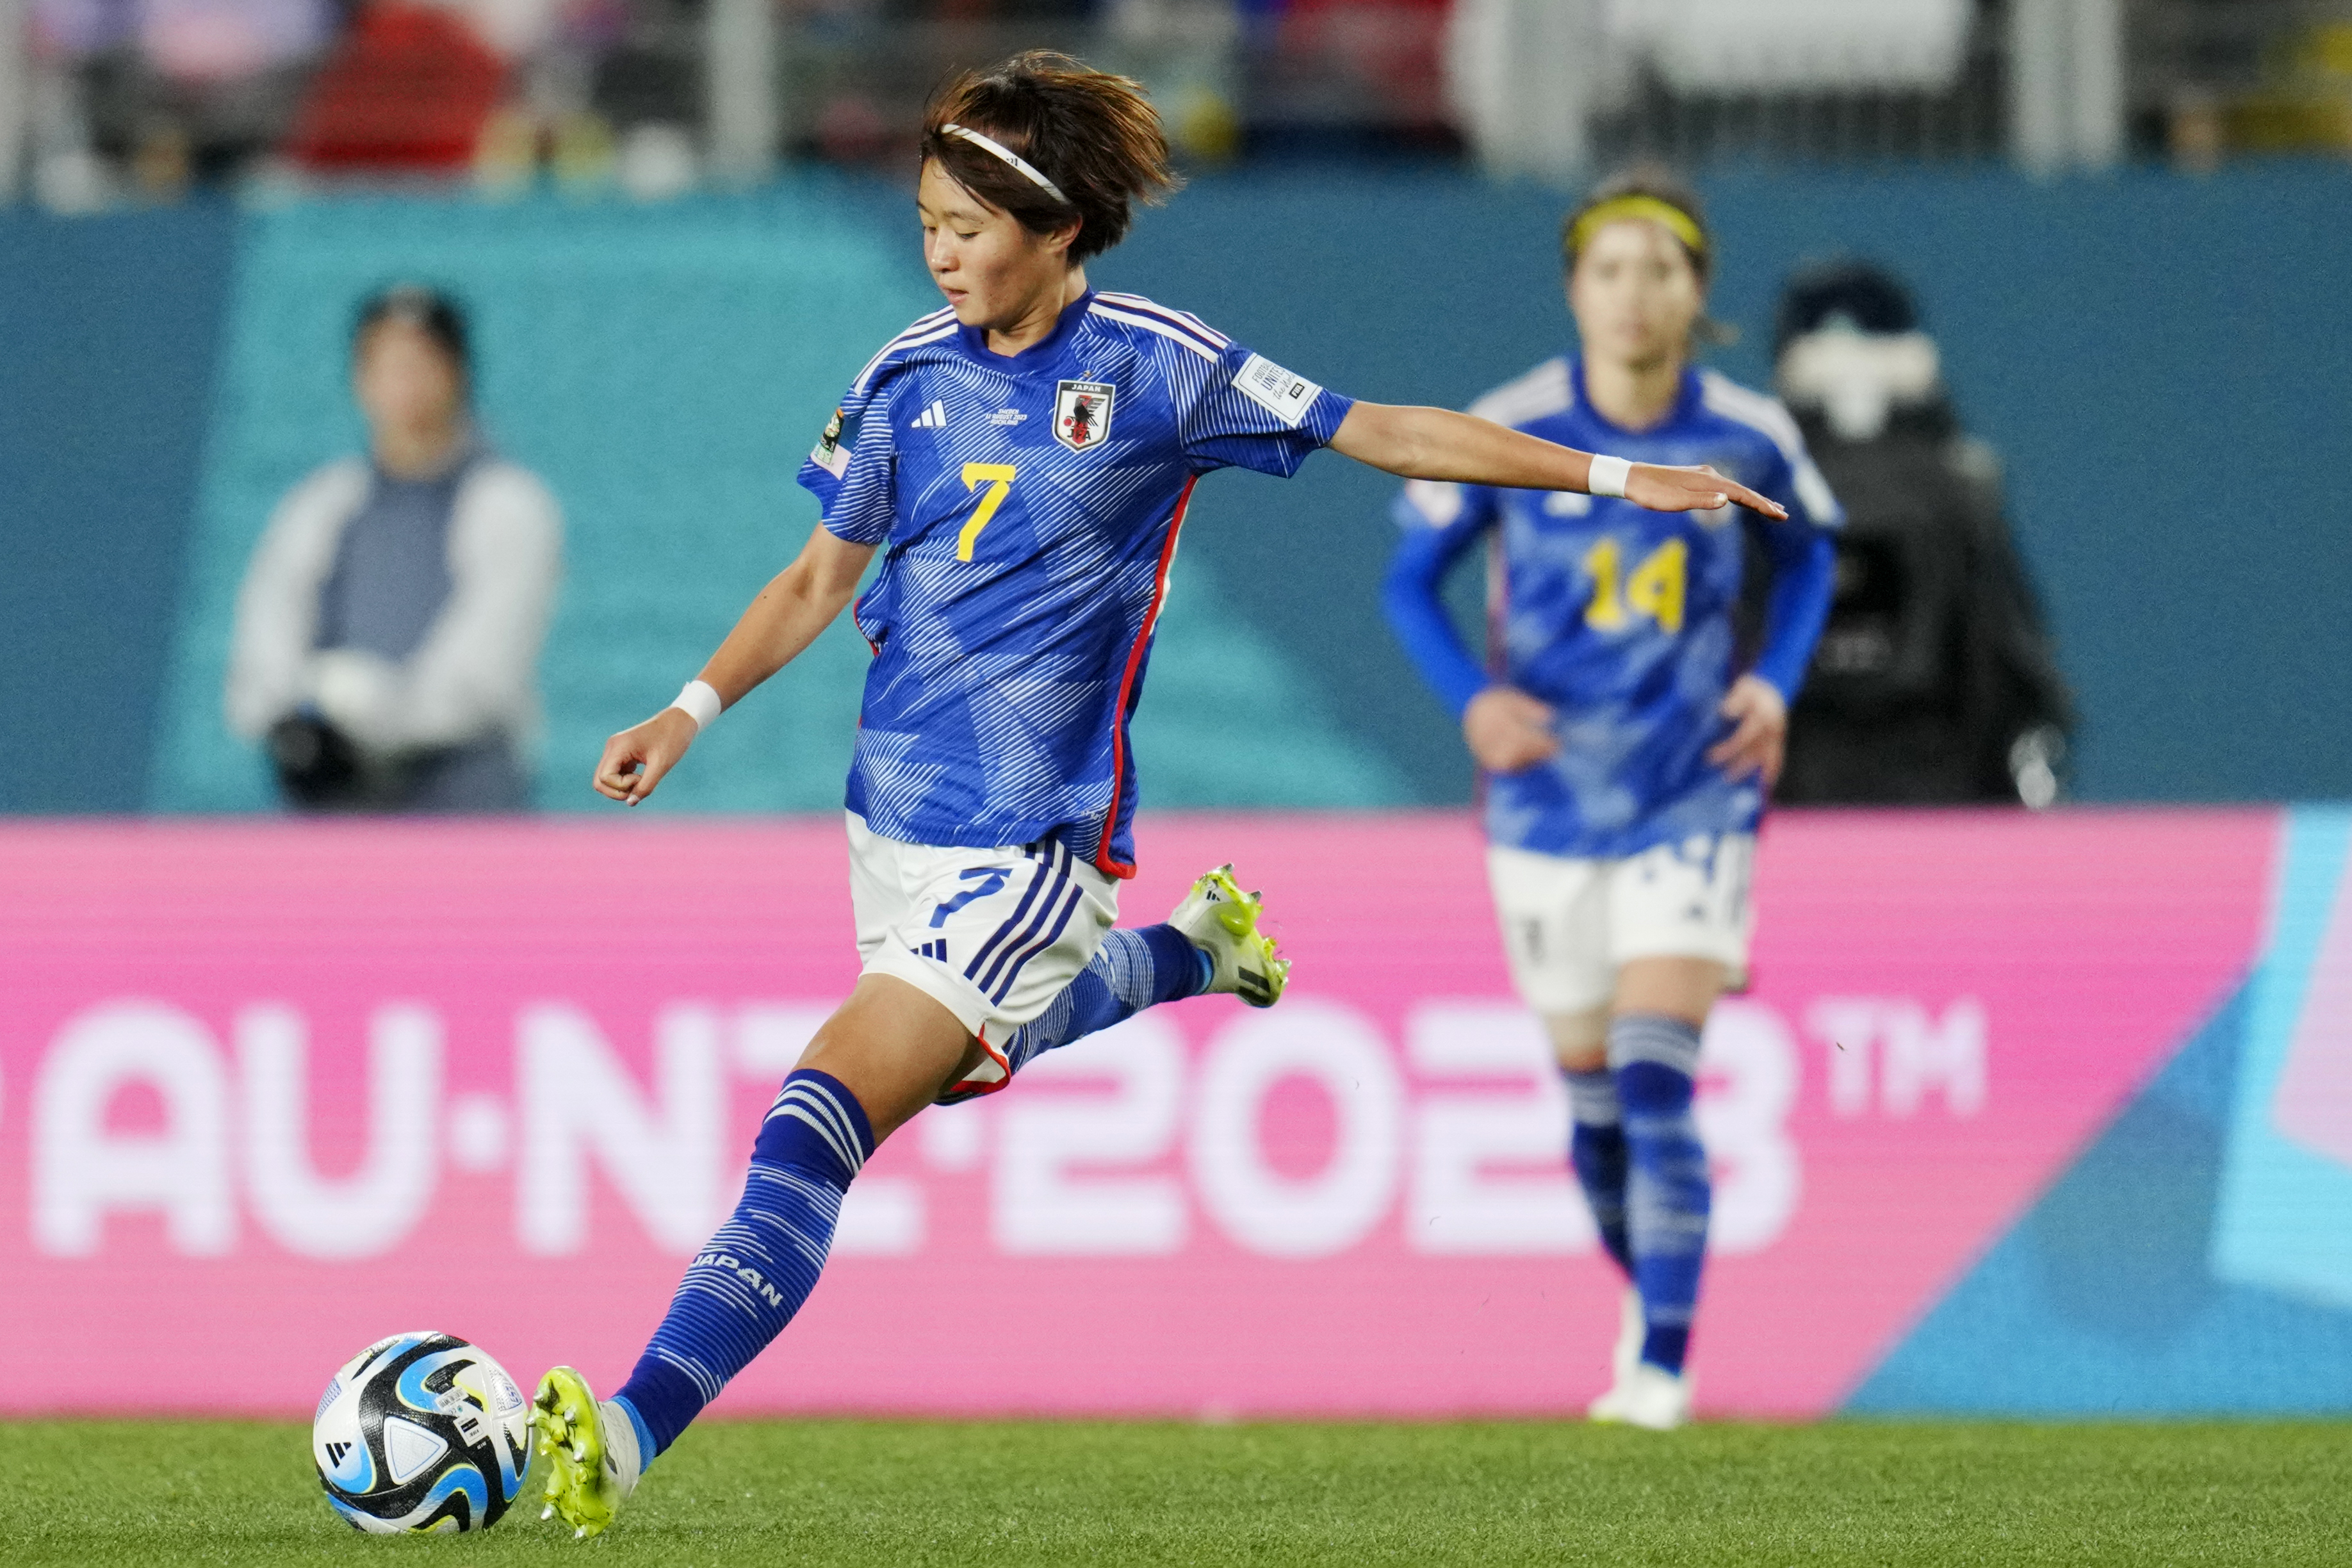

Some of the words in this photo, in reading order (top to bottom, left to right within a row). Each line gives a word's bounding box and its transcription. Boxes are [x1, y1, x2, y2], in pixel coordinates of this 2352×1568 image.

[1072, 384, 1101, 392] JAPAN
[1261, 364, 1286, 391] UNITES
[1291, 383, 1303, 397] FIFA
[961, 463, 1017, 562] 7
[1583, 536, 1690, 634] 14
[929, 867, 1013, 928] 7
[689, 1254, 783, 1307] JAPAN
